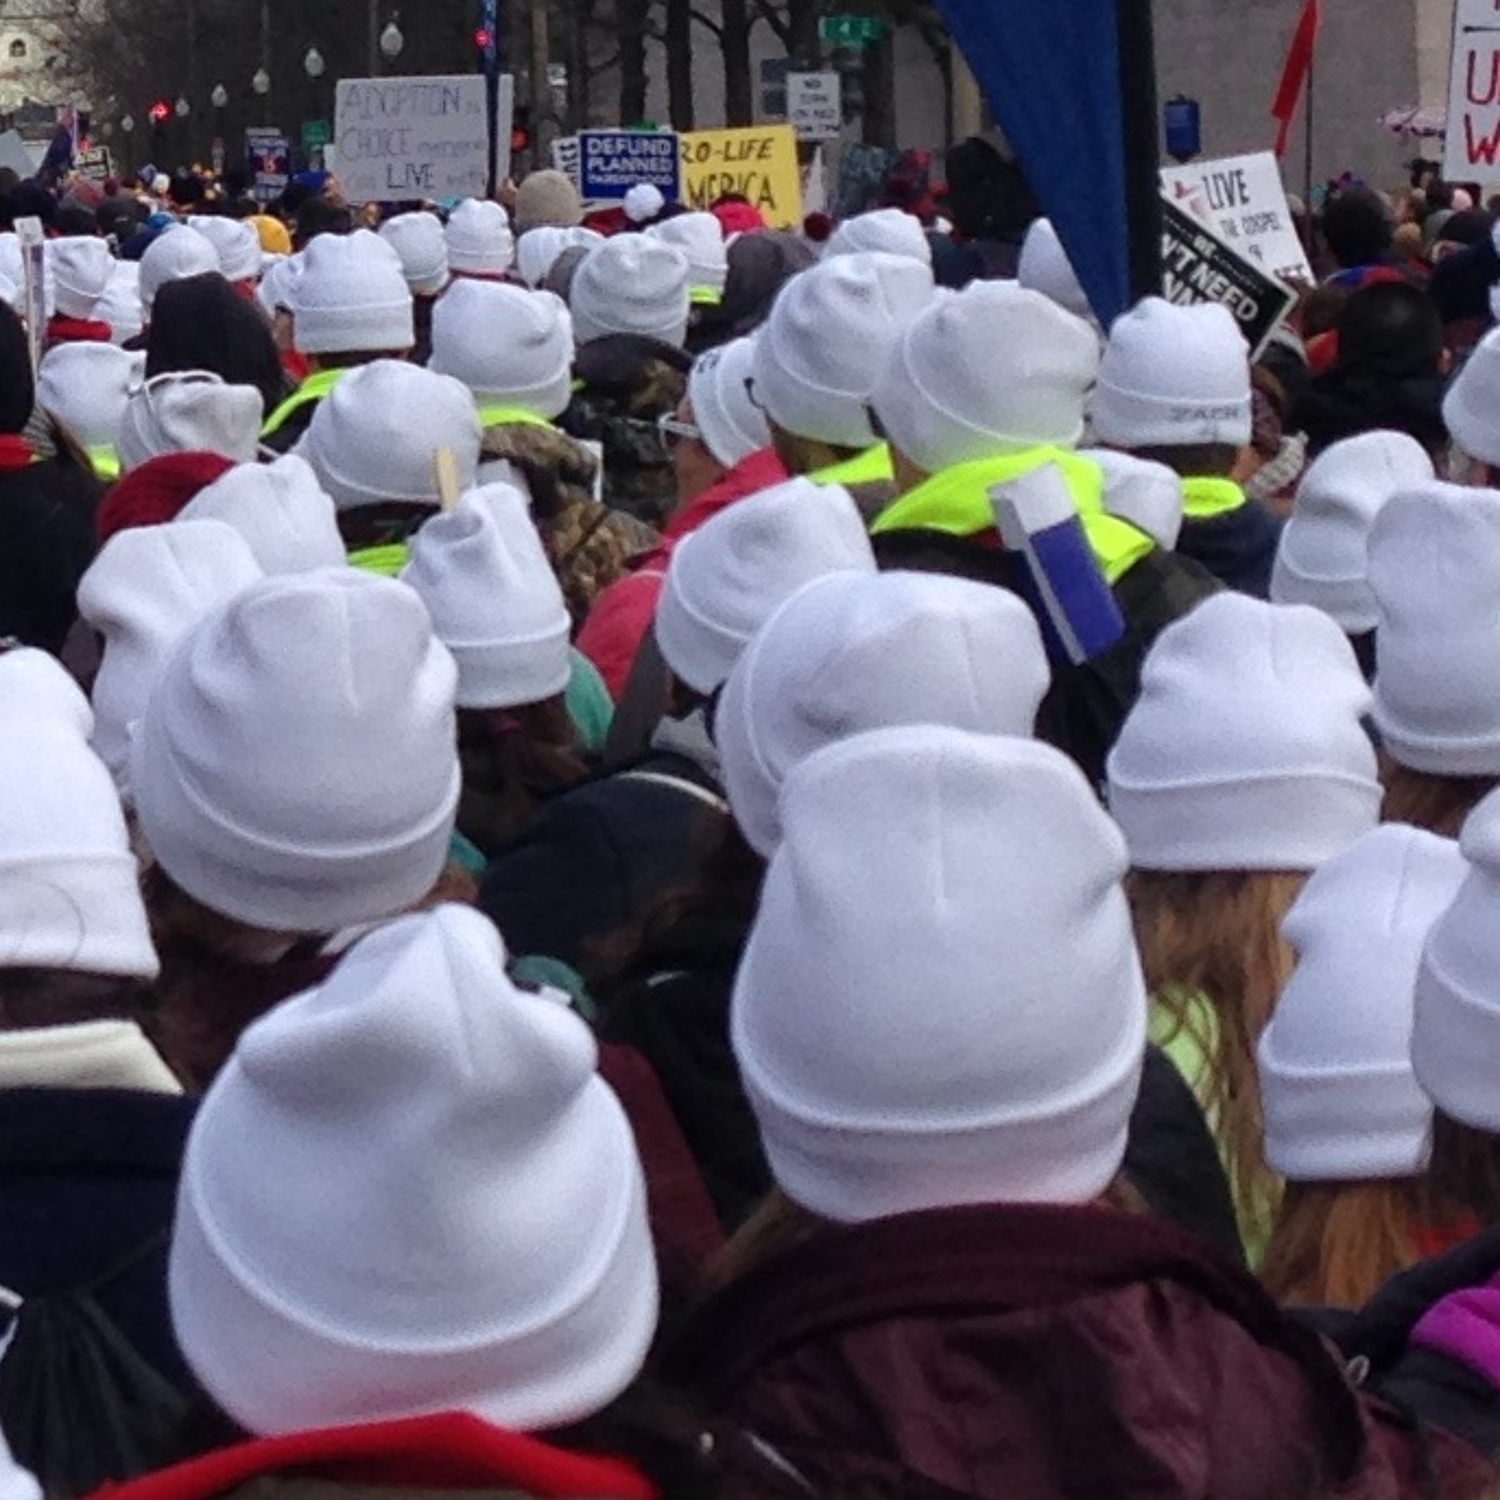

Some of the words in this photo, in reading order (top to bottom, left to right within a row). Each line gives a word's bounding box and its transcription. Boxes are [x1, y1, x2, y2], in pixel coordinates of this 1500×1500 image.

[587, 136, 672, 156] DEFUND
[386, 163, 436, 190] LIVE
[587, 156, 673, 173] PLANNED
[1202, 168, 1250, 211] LIVE
[1189, 261, 1260, 321] NEED
